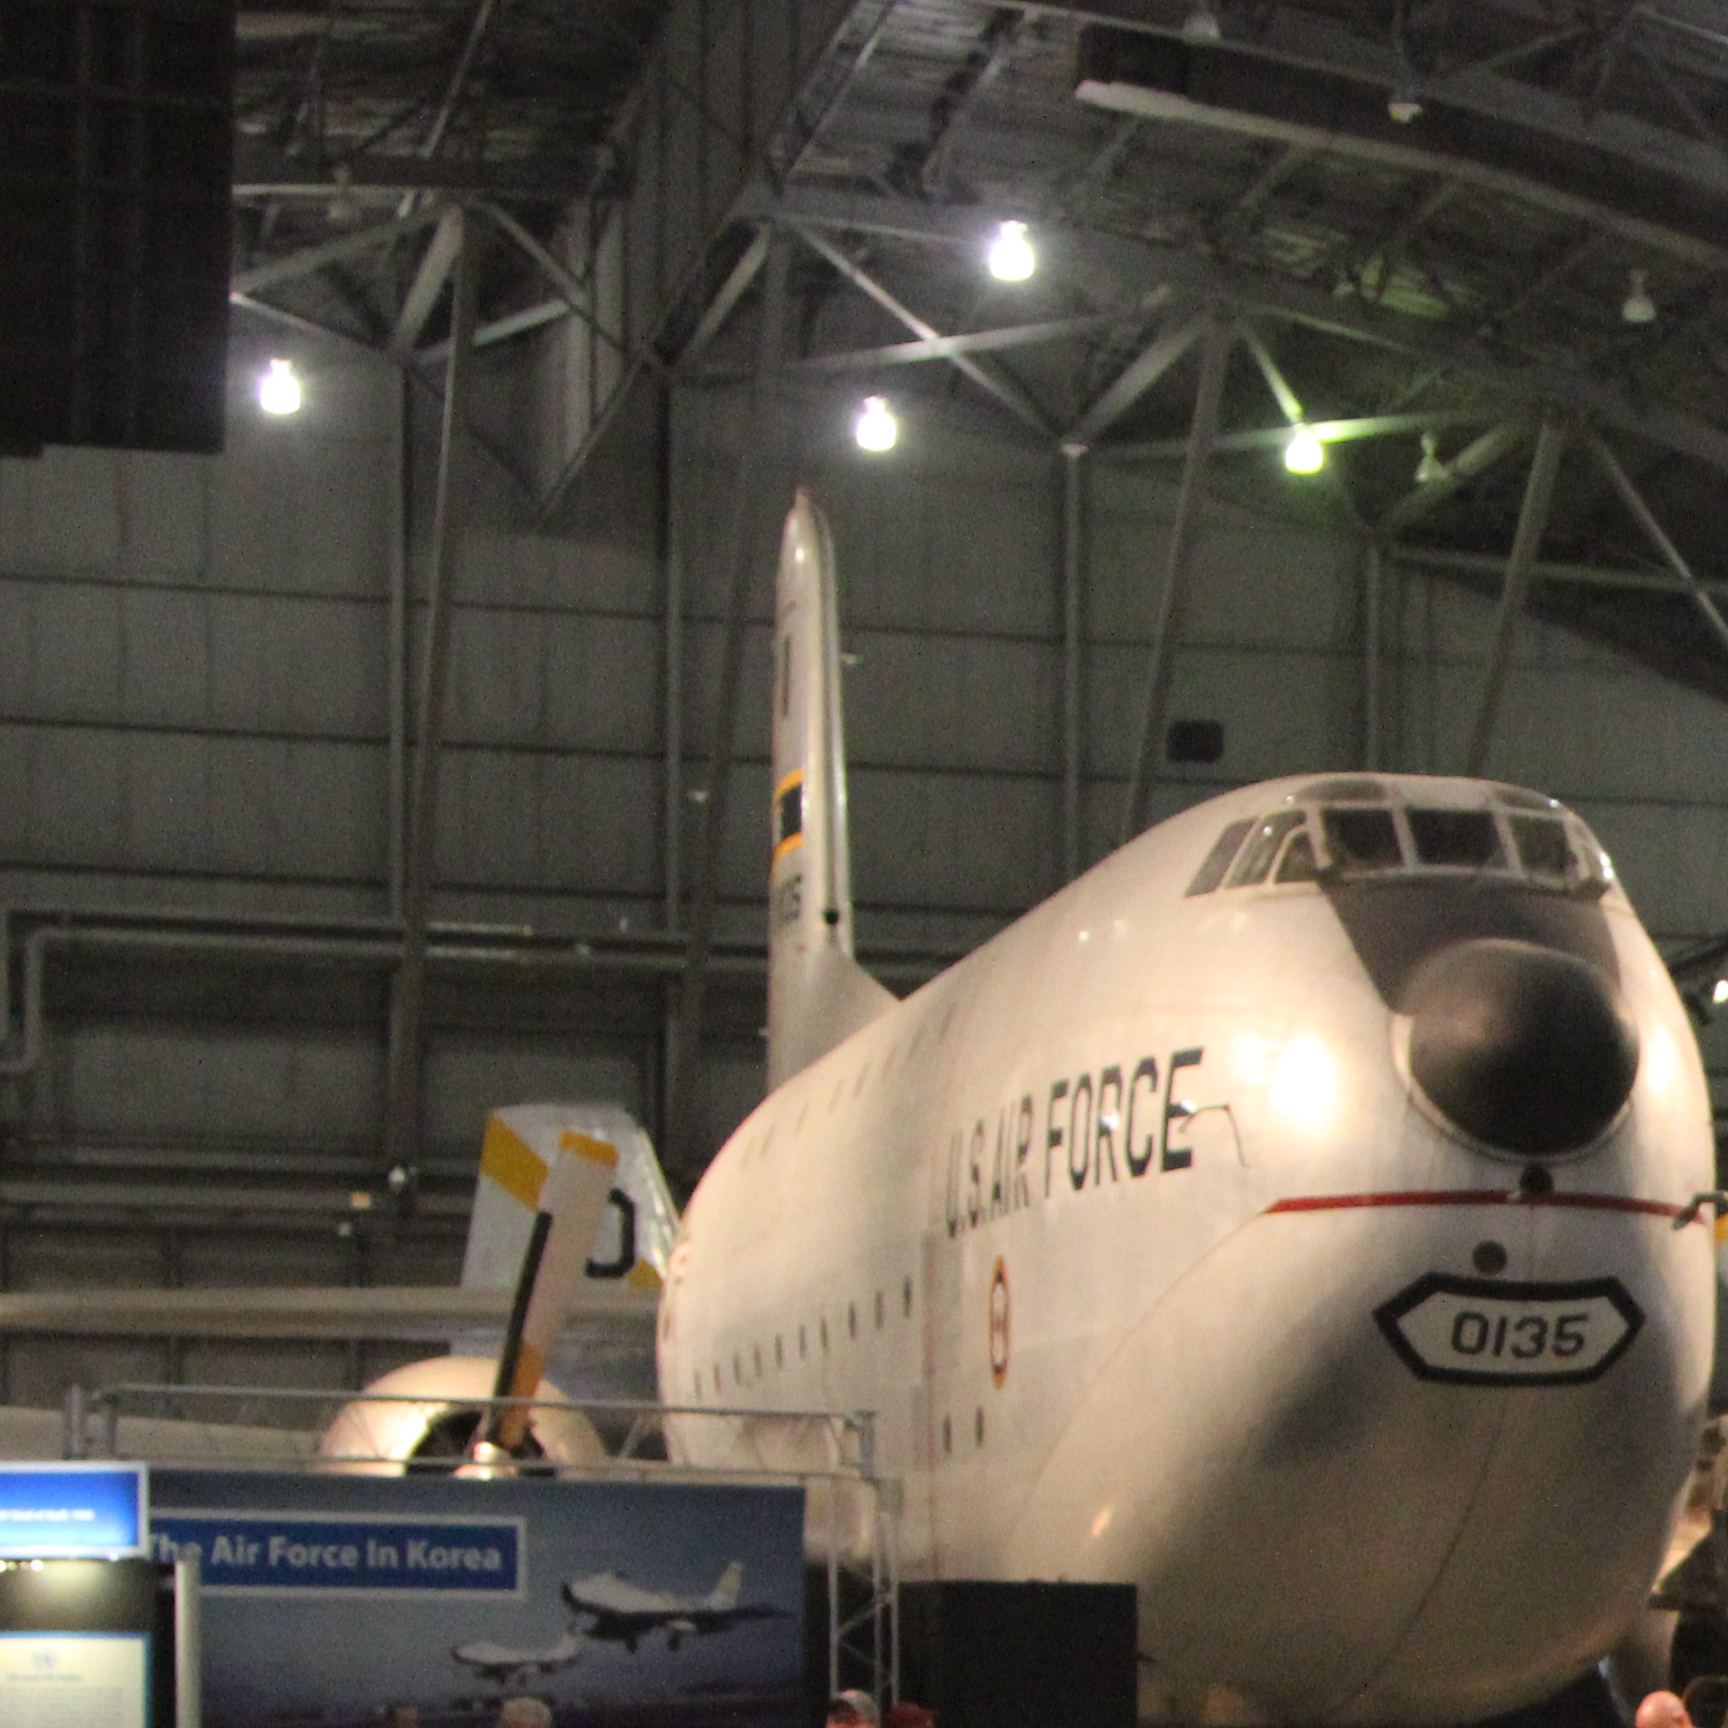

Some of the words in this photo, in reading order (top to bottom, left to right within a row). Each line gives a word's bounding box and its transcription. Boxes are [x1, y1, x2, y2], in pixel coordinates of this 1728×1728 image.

[1044, 1045, 1205, 1200] FORCE
[1451, 1310, 1589, 1360] 0135
[210, 1534, 261, 1567] Air
[268, 1536, 359, 1568] Force
[367, 1538, 400, 1569] In
[406, 1539, 501, 1571] Korea
